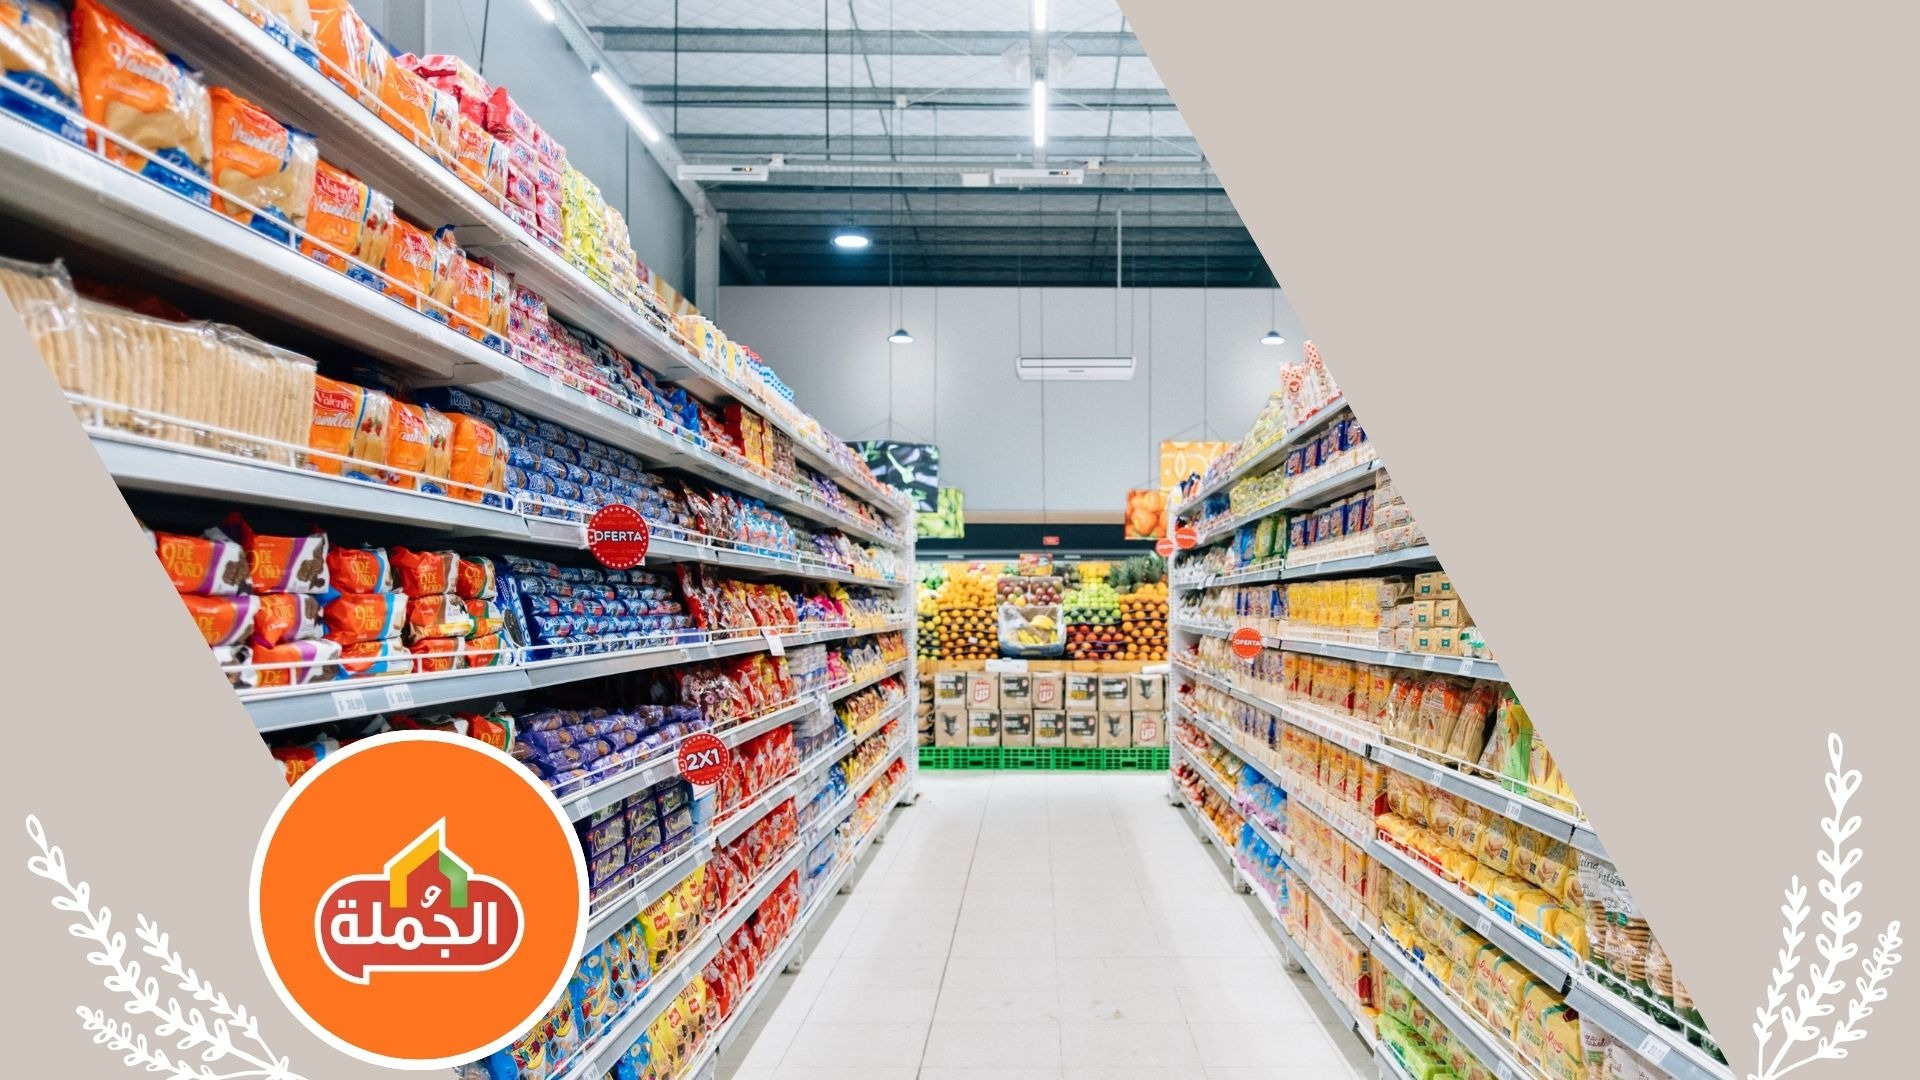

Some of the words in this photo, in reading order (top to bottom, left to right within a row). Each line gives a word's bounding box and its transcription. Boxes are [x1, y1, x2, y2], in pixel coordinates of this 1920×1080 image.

[315, 391, 353, 411] Valente
[594, 530, 643, 542] OFERTA
[1234, 639, 1260, 647] OFERTA
[686, 748, 720, 771] 2X1
